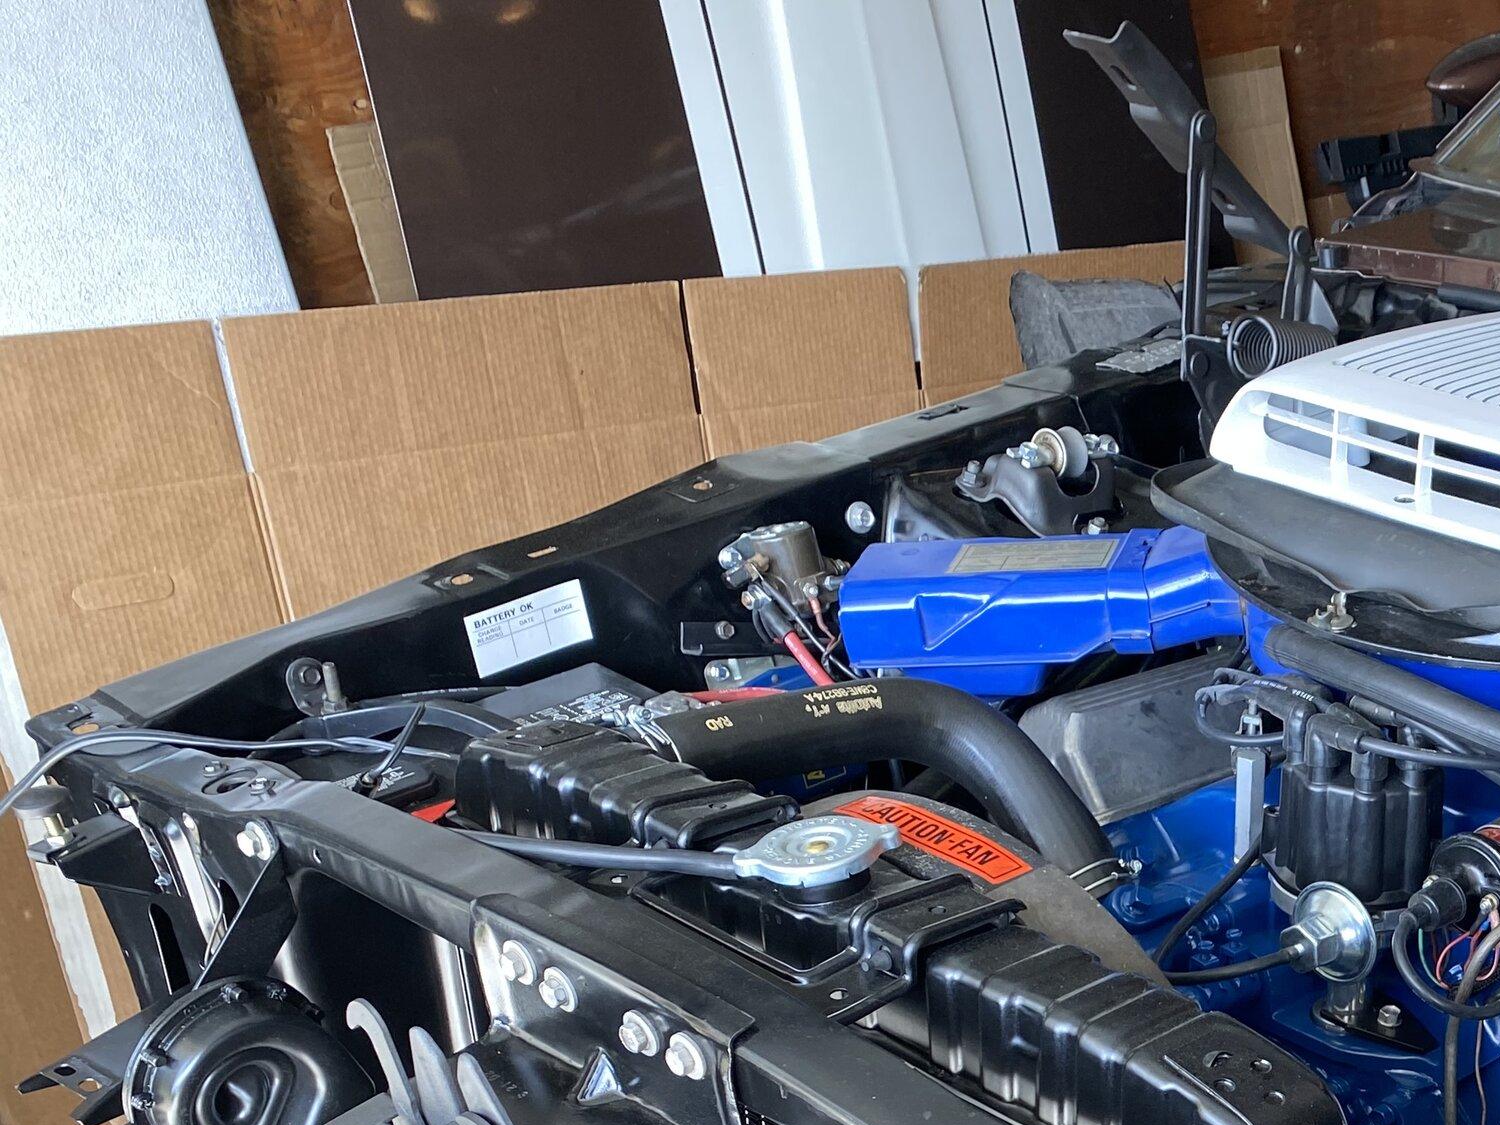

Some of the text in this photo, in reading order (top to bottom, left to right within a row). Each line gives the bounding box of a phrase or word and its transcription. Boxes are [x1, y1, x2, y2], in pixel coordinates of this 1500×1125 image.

[474, 602, 534, 629] BATTERY OK
[553, 603, 573, 614] BADGE
[519, 616, 535, 625] DATE
[705, 715, 734, 732] RAD
[860, 801, 999, 867] CAUTION-FAN
